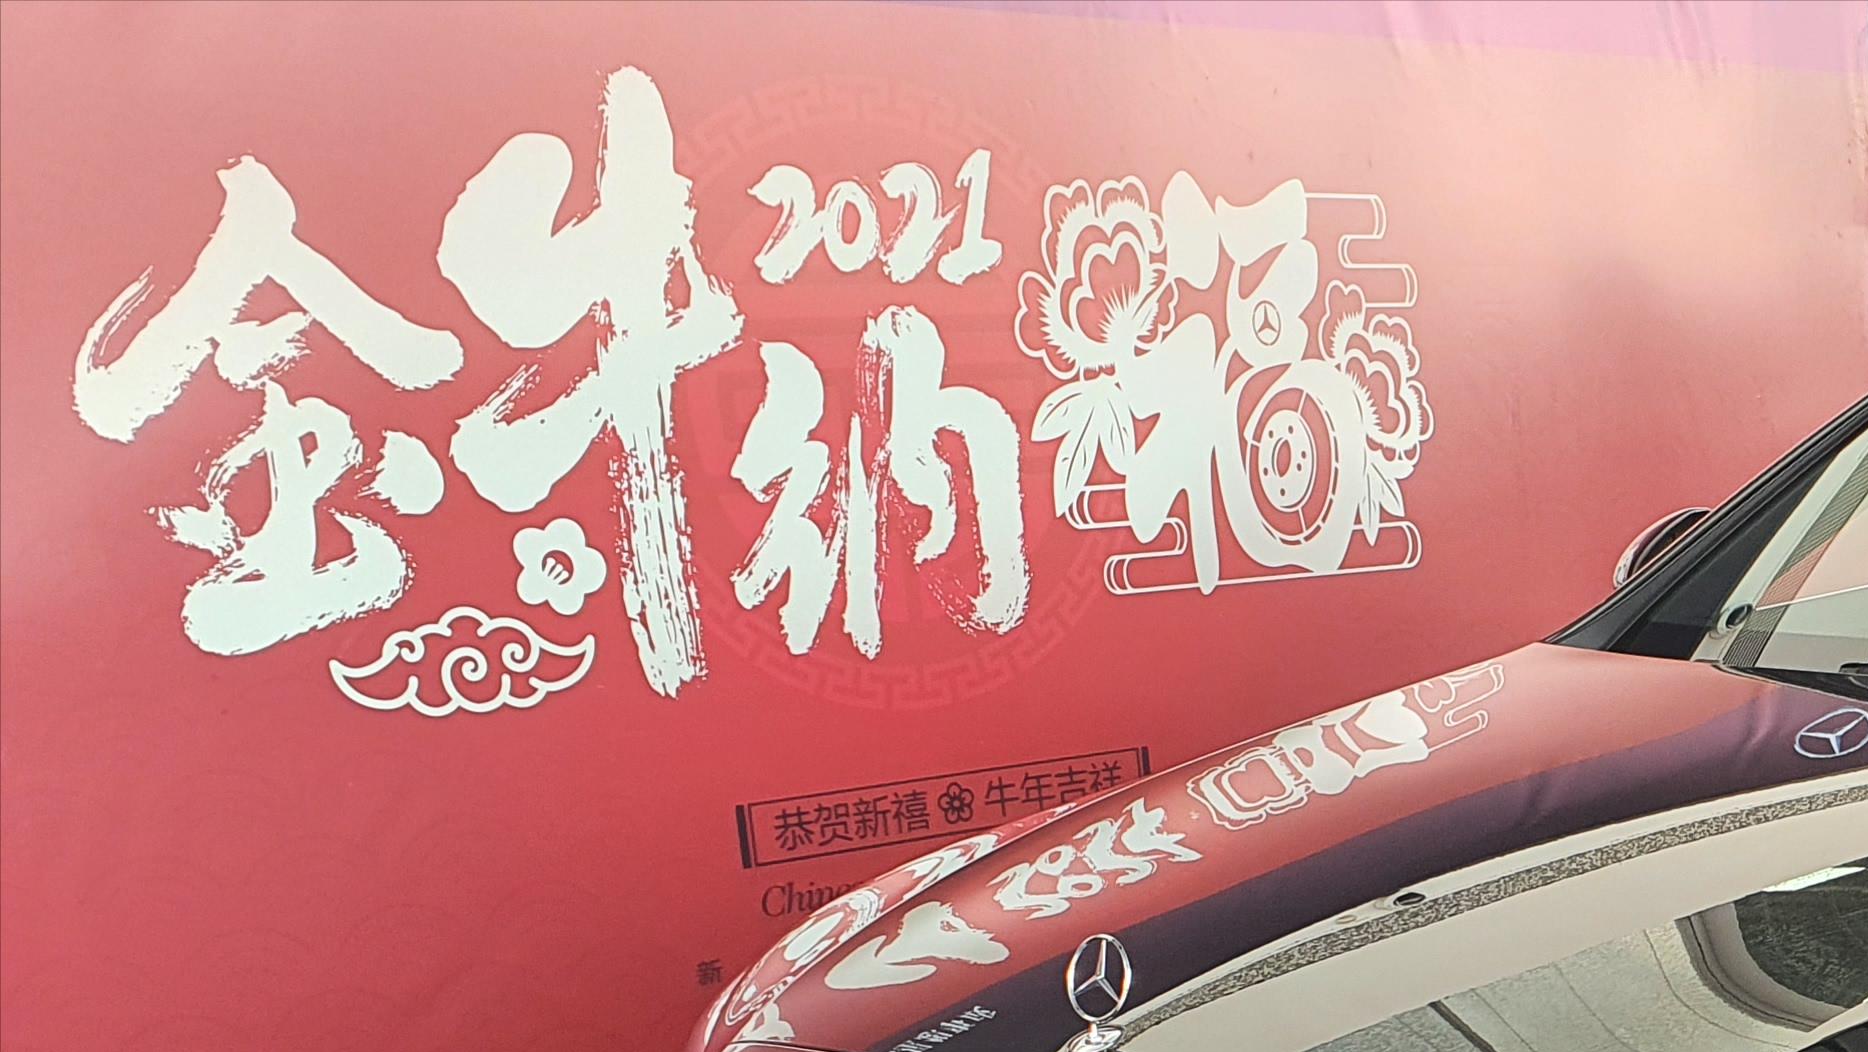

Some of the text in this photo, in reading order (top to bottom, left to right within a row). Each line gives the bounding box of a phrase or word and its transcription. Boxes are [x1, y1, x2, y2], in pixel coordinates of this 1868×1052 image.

[747, 148, 1003, 285] 2021
[774, 760, 1122, 851] 恭贺新禧 牛年吉祥
